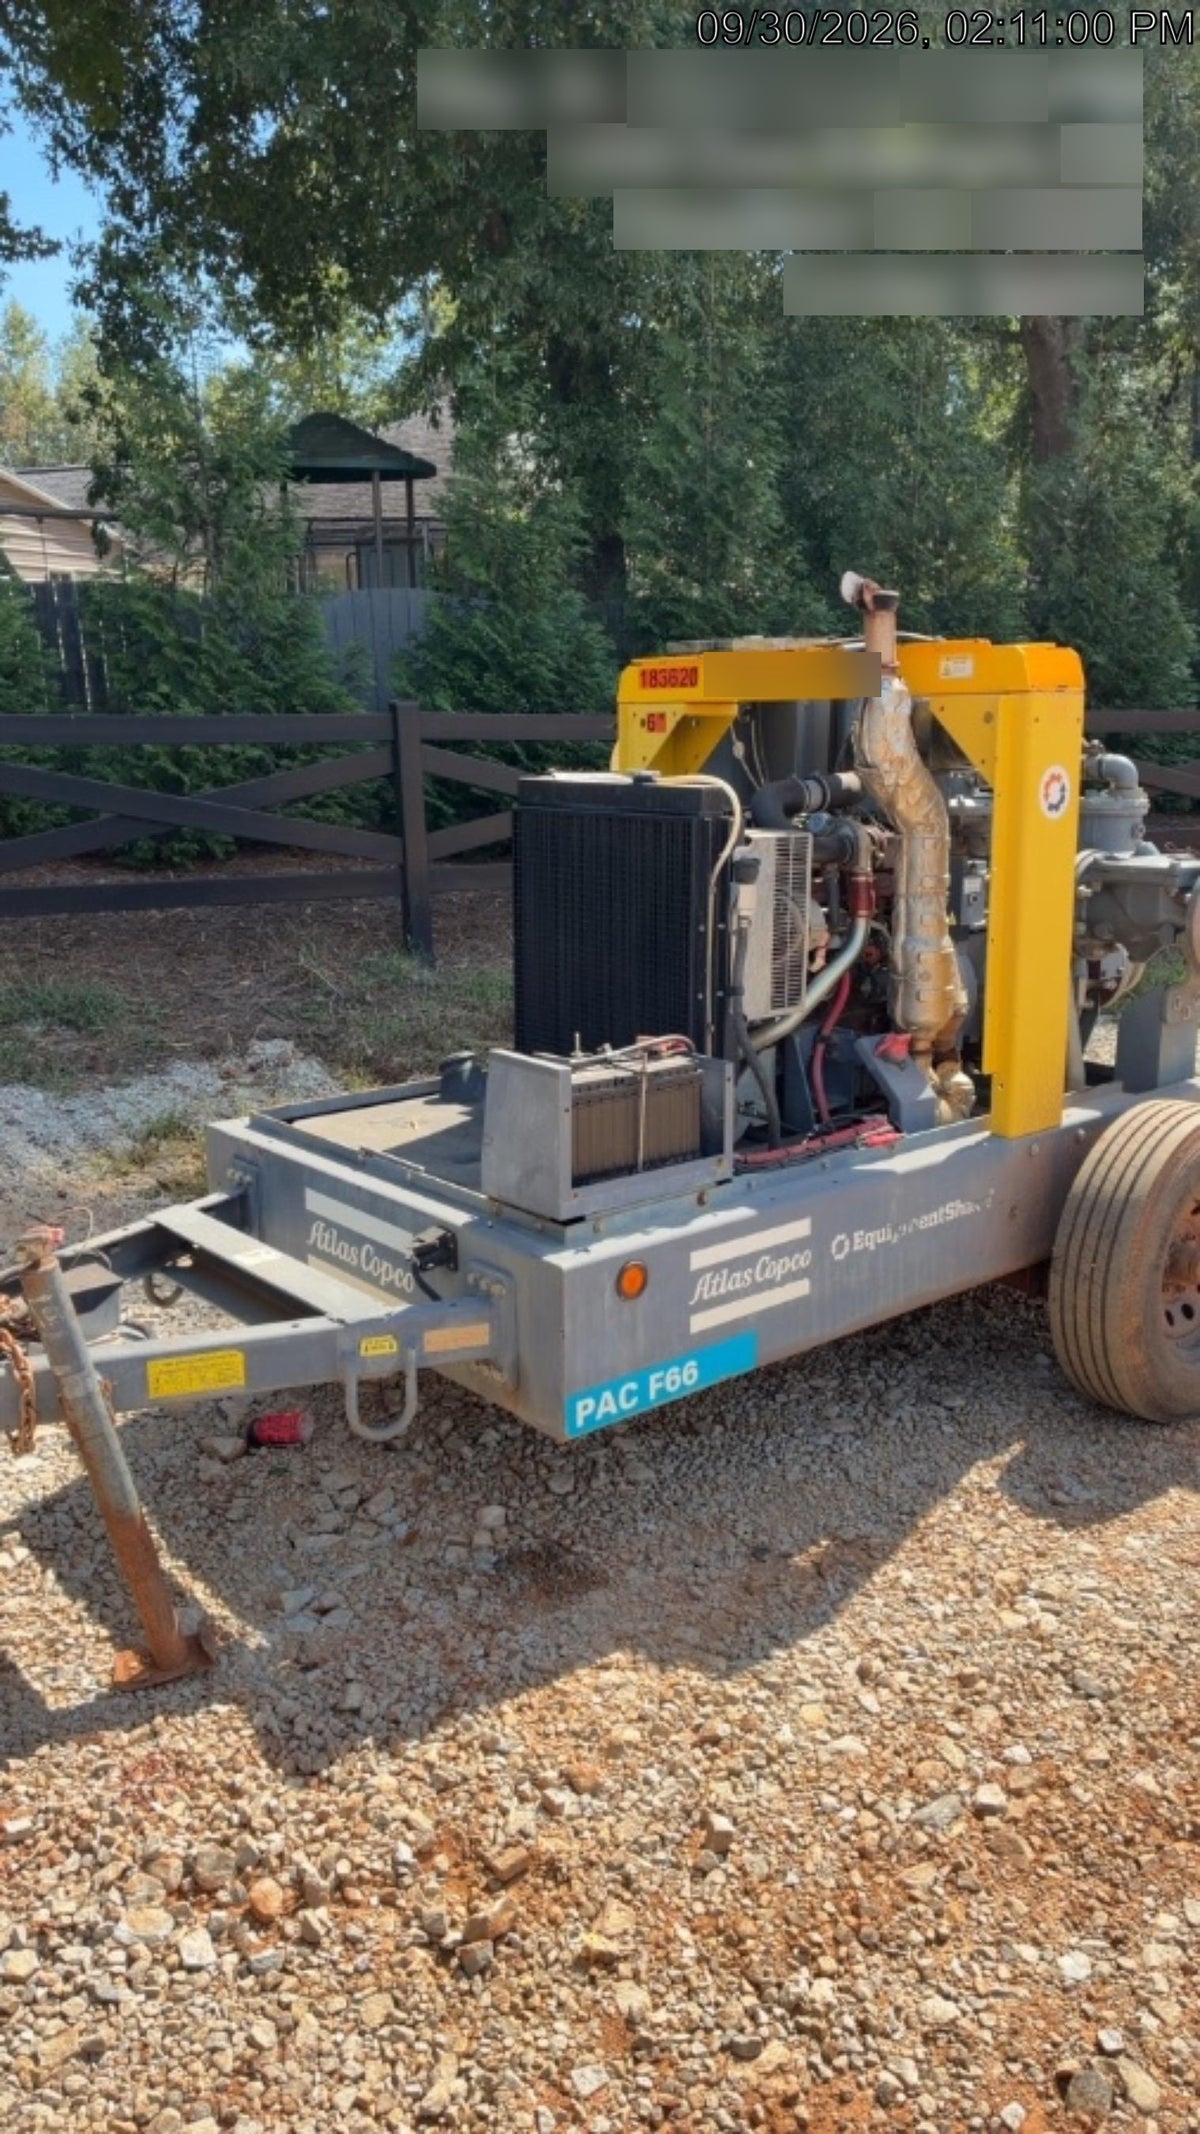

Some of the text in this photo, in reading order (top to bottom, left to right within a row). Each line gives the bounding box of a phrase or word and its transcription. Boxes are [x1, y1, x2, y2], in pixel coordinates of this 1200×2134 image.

[306, 1221, 415, 1293] Atlas Copco
[688, 1249, 812, 1305] Atlas Copco
[575, 1359, 698, 1428] PAC F66
